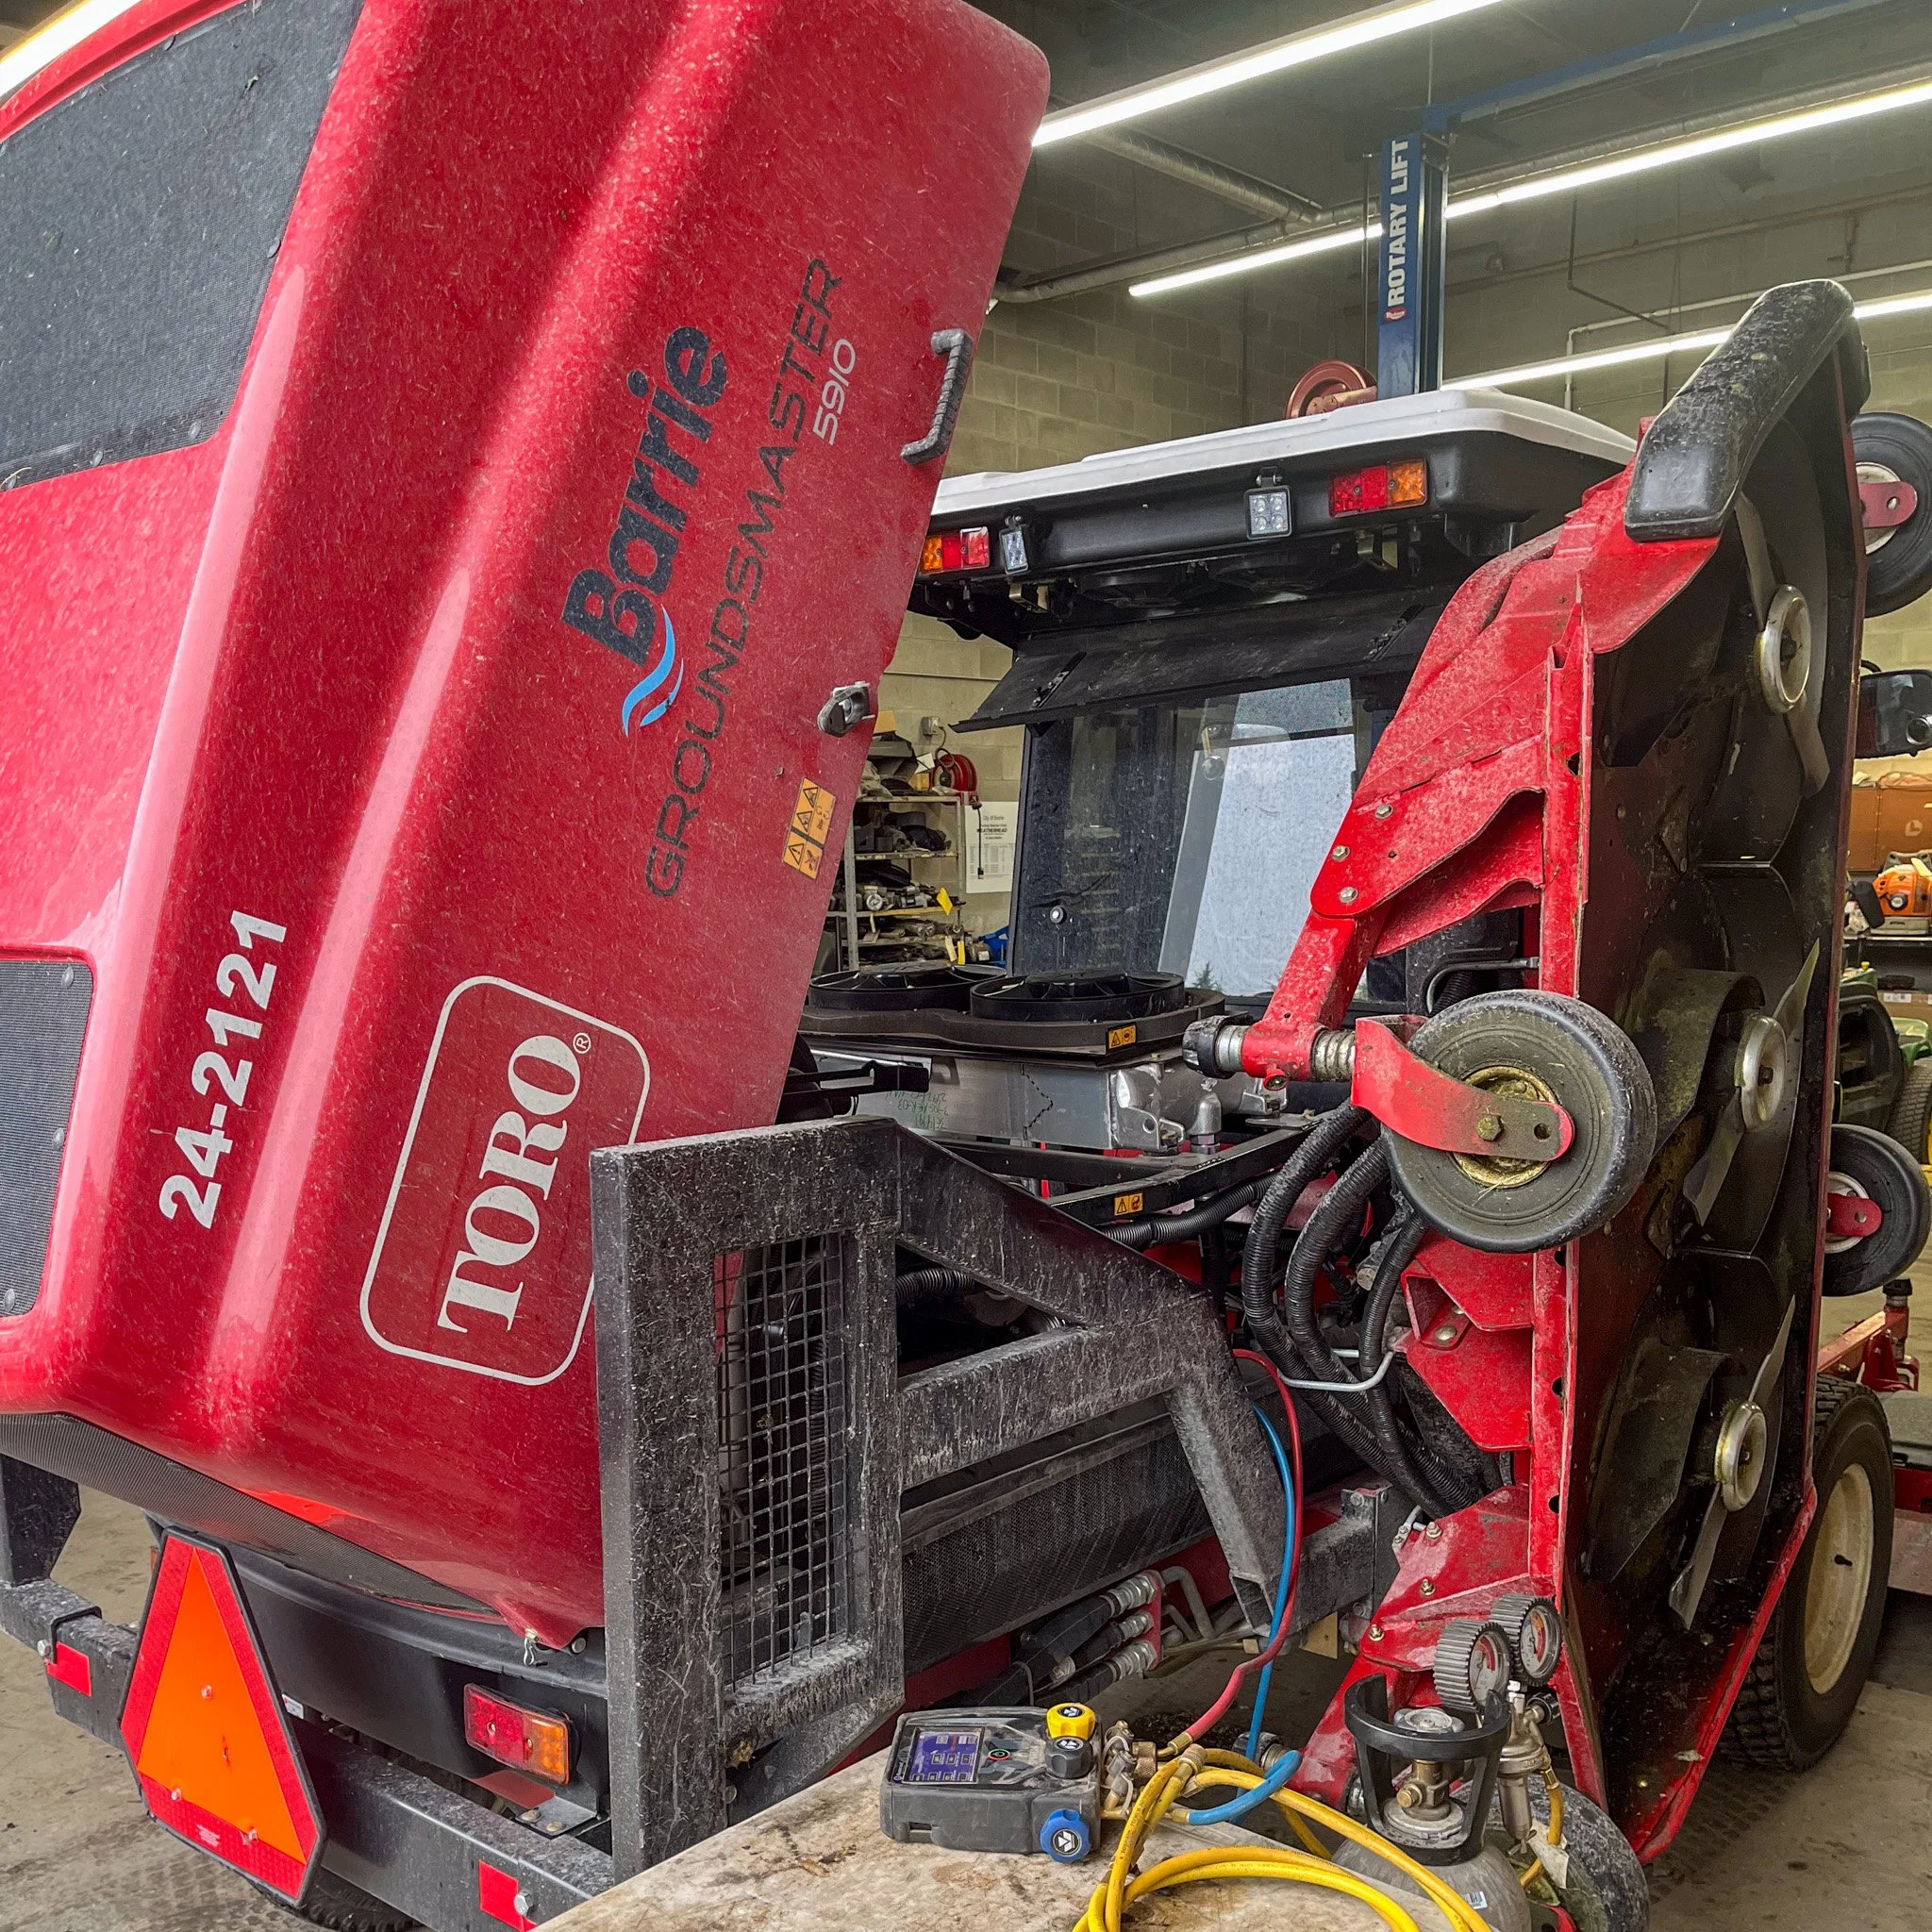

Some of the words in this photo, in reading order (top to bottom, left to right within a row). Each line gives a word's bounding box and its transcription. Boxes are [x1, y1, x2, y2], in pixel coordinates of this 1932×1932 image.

[1388, 202, 1407, 308] ROTARY
[1391, 140, 1409, 195] LIFT
[561, 326, 729, 665] Barrie
[812, 337, 857, 446] 5910
[645, 258, 842, 898] GROUNDSMASTER
[158, 909, 287, 1229] 24-2121
[437, 1034, 581, 1333] TORO
